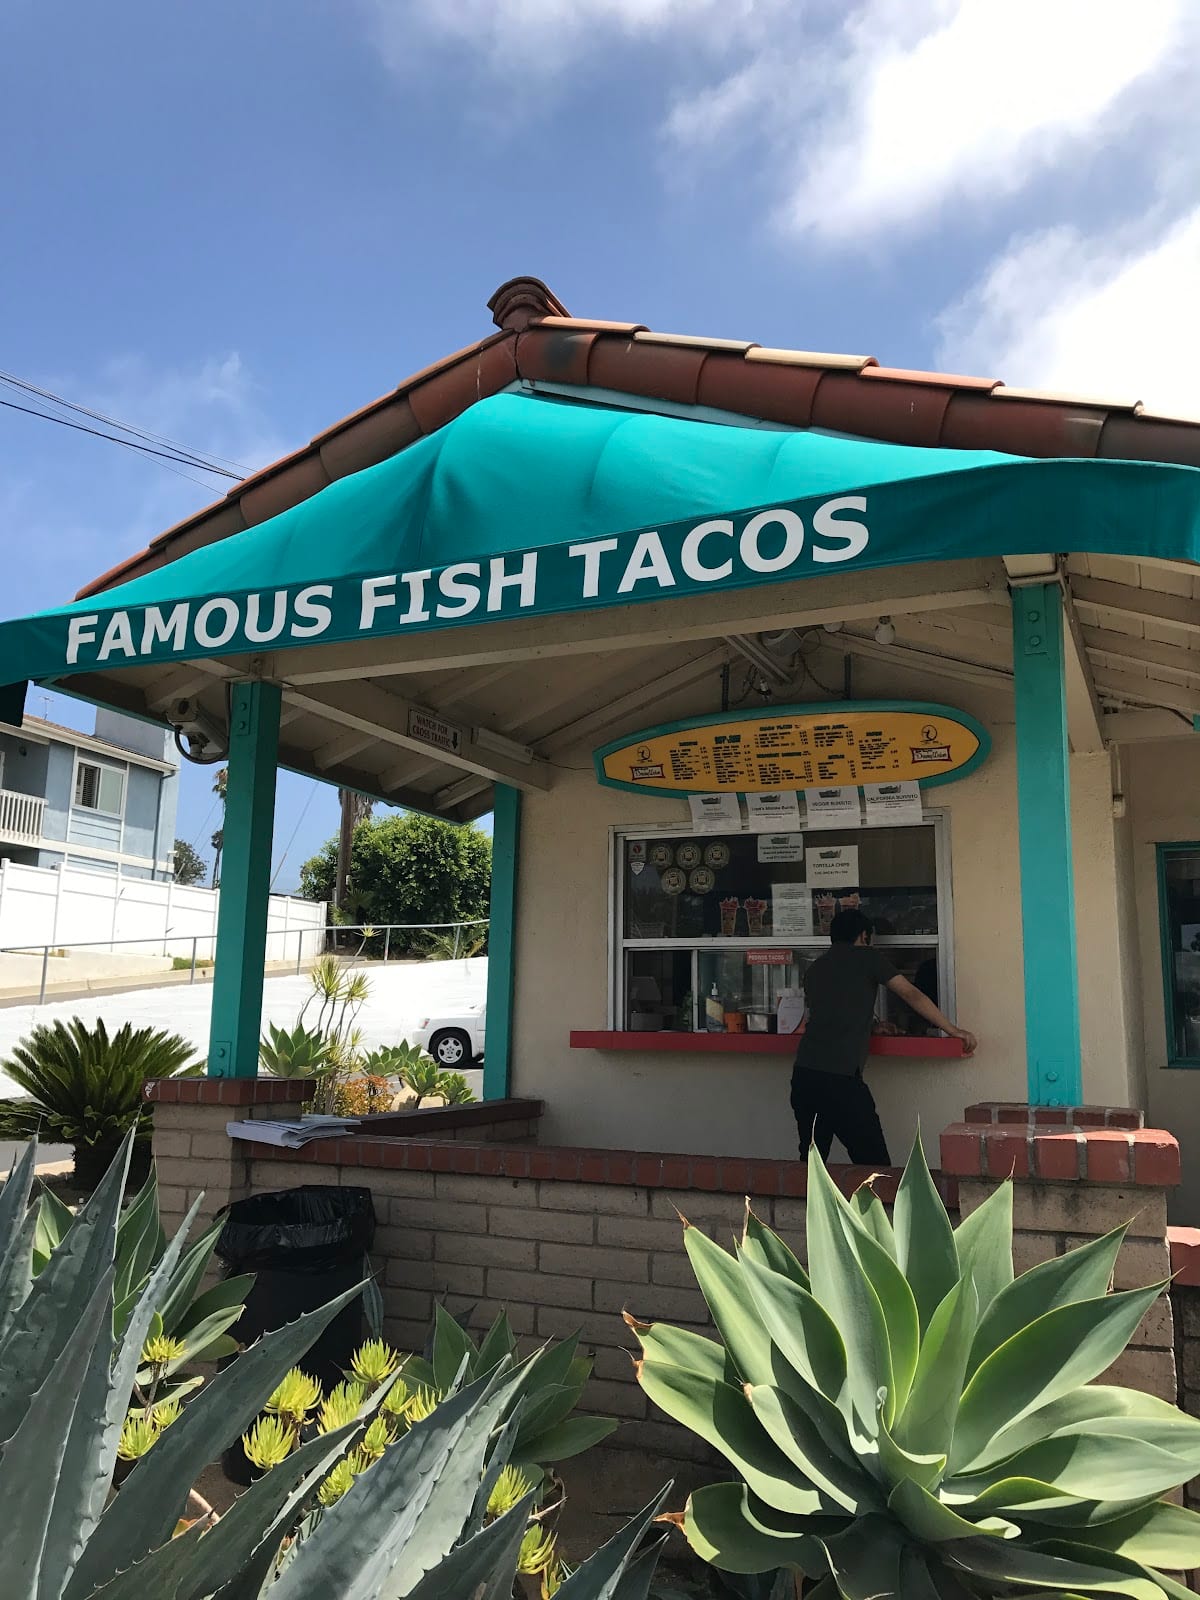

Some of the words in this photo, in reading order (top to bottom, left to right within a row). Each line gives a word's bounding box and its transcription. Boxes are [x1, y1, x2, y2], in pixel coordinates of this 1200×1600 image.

[66, 585, 333, 664] FAMOUS
[358, 552, 538, 630] FISH
[568, 496, 869, 598] TACOS
[412, 724, 431, 740] CROSS
[416, 714, 437, 731] WATCH
[437, 723, 448, 736] FOR
